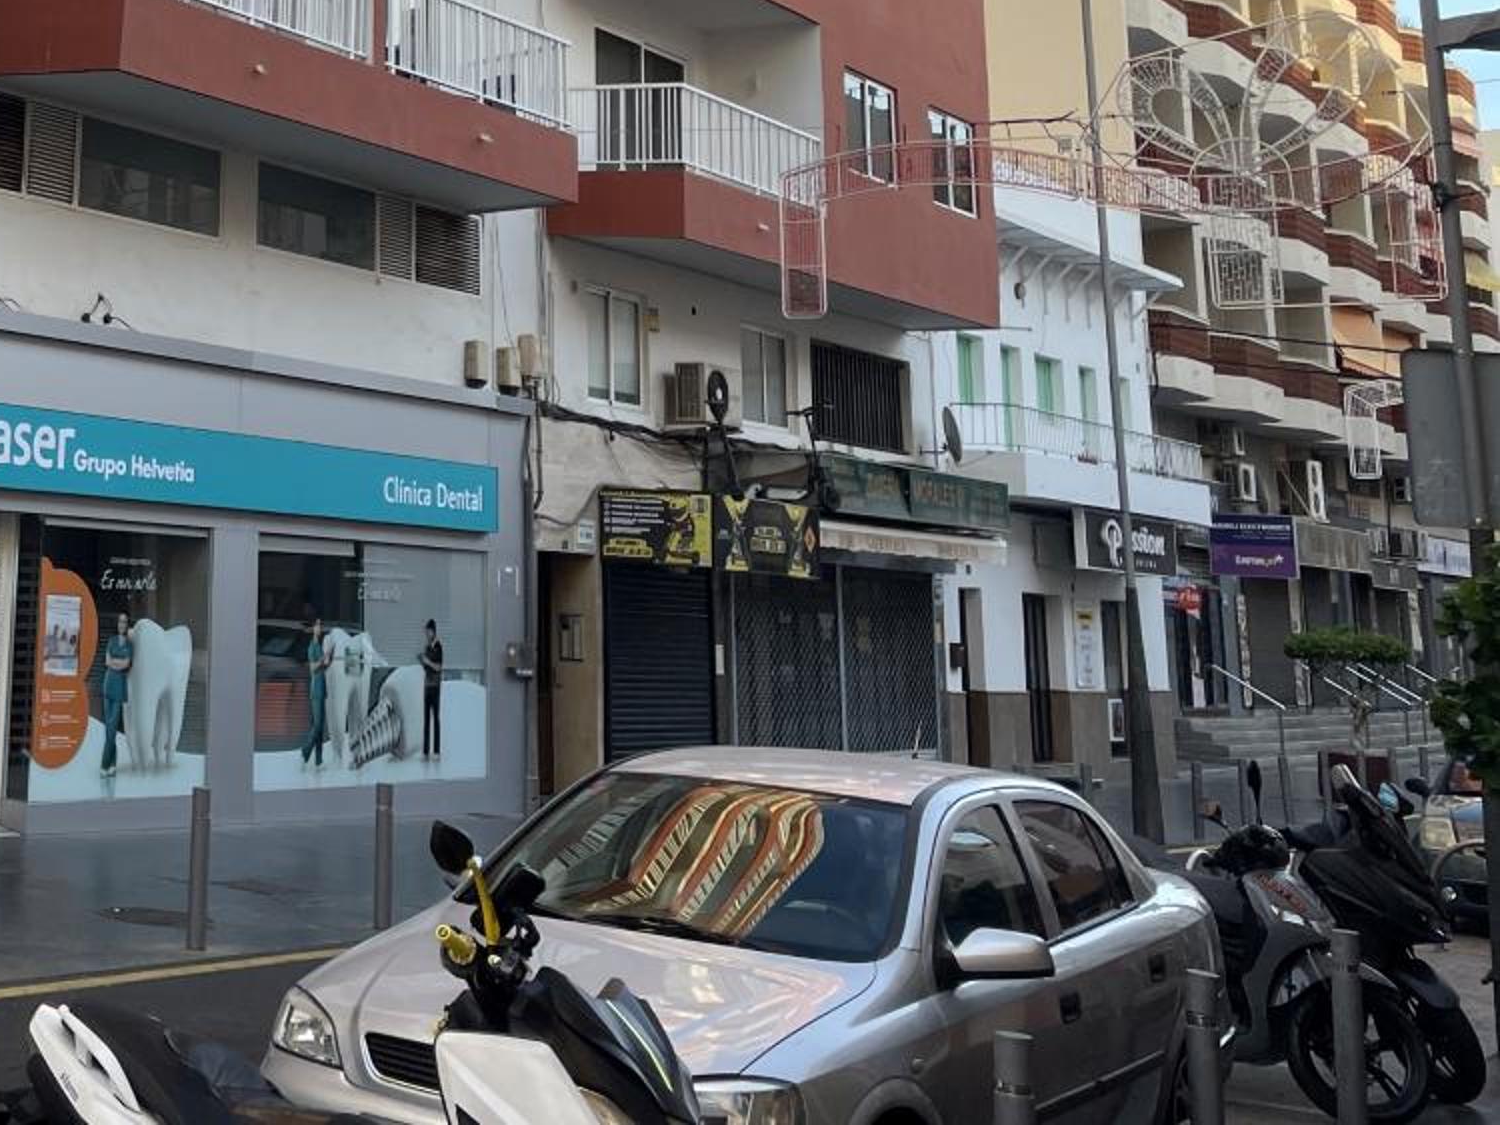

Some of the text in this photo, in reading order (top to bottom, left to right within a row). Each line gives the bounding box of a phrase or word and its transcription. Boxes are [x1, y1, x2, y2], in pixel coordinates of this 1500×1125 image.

[73, 449, 127, 481] Grupo
[131, 455, 196, 483] Helvetia
[383, 475, 483, 512] Clínica Dental
[1101, 519, 1165, 568] Pssion
